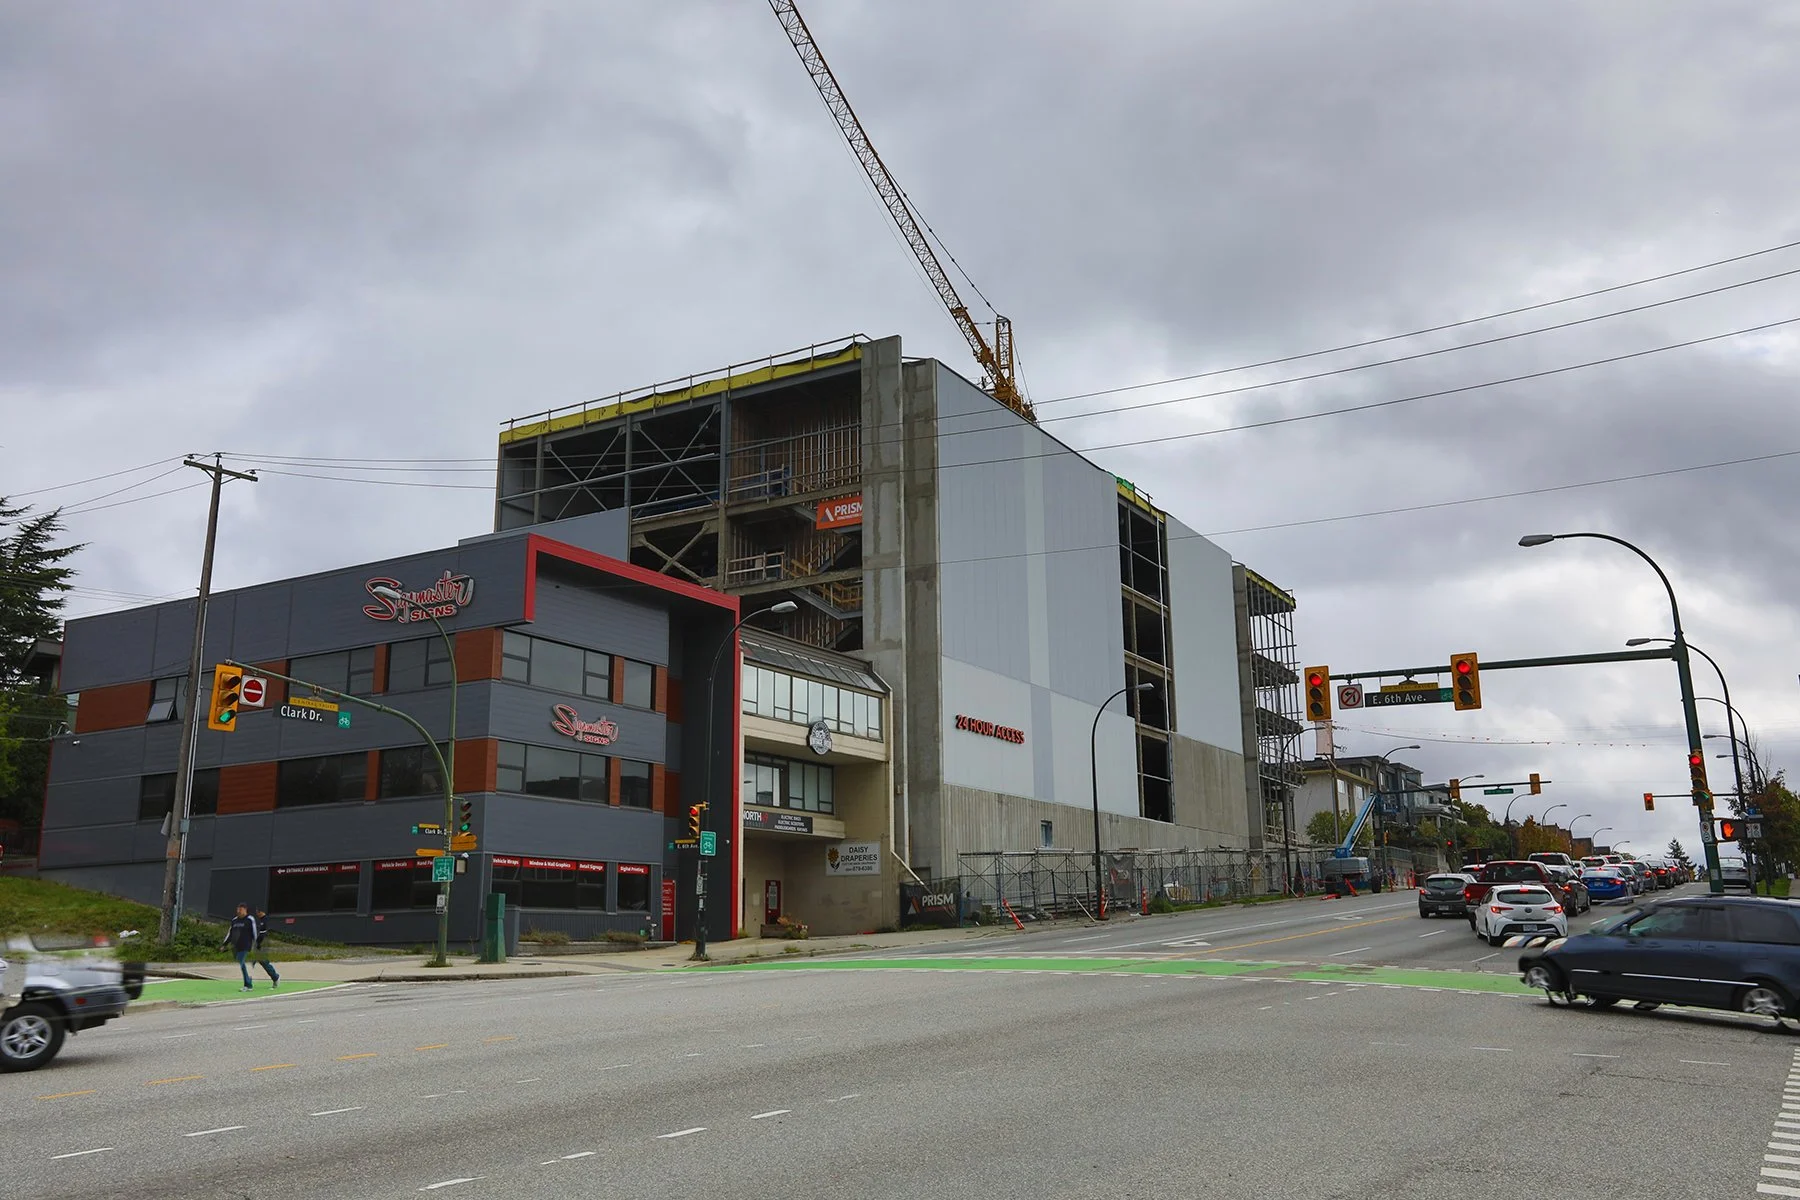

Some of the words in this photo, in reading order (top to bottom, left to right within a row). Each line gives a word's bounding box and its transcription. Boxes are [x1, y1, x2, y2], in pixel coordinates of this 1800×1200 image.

[410, 604, 456, 622] SIGNS
[1372, 696, 1382, 704] E.
[1384, 694, 1402, 704] 6th
[1404, 692, 1426, 702] Ave.
[281, 706, 307, 719] Clark
[310, 710, 322, 722] Dr.
[956, 714, 968, 730] 24
[968, 718, 994, 736] HOUR
[994, 725, 1024, 744] ACCESS
[584, 735, 610, 746] SIGNS
[922, 893, 954, 906] PRISM
